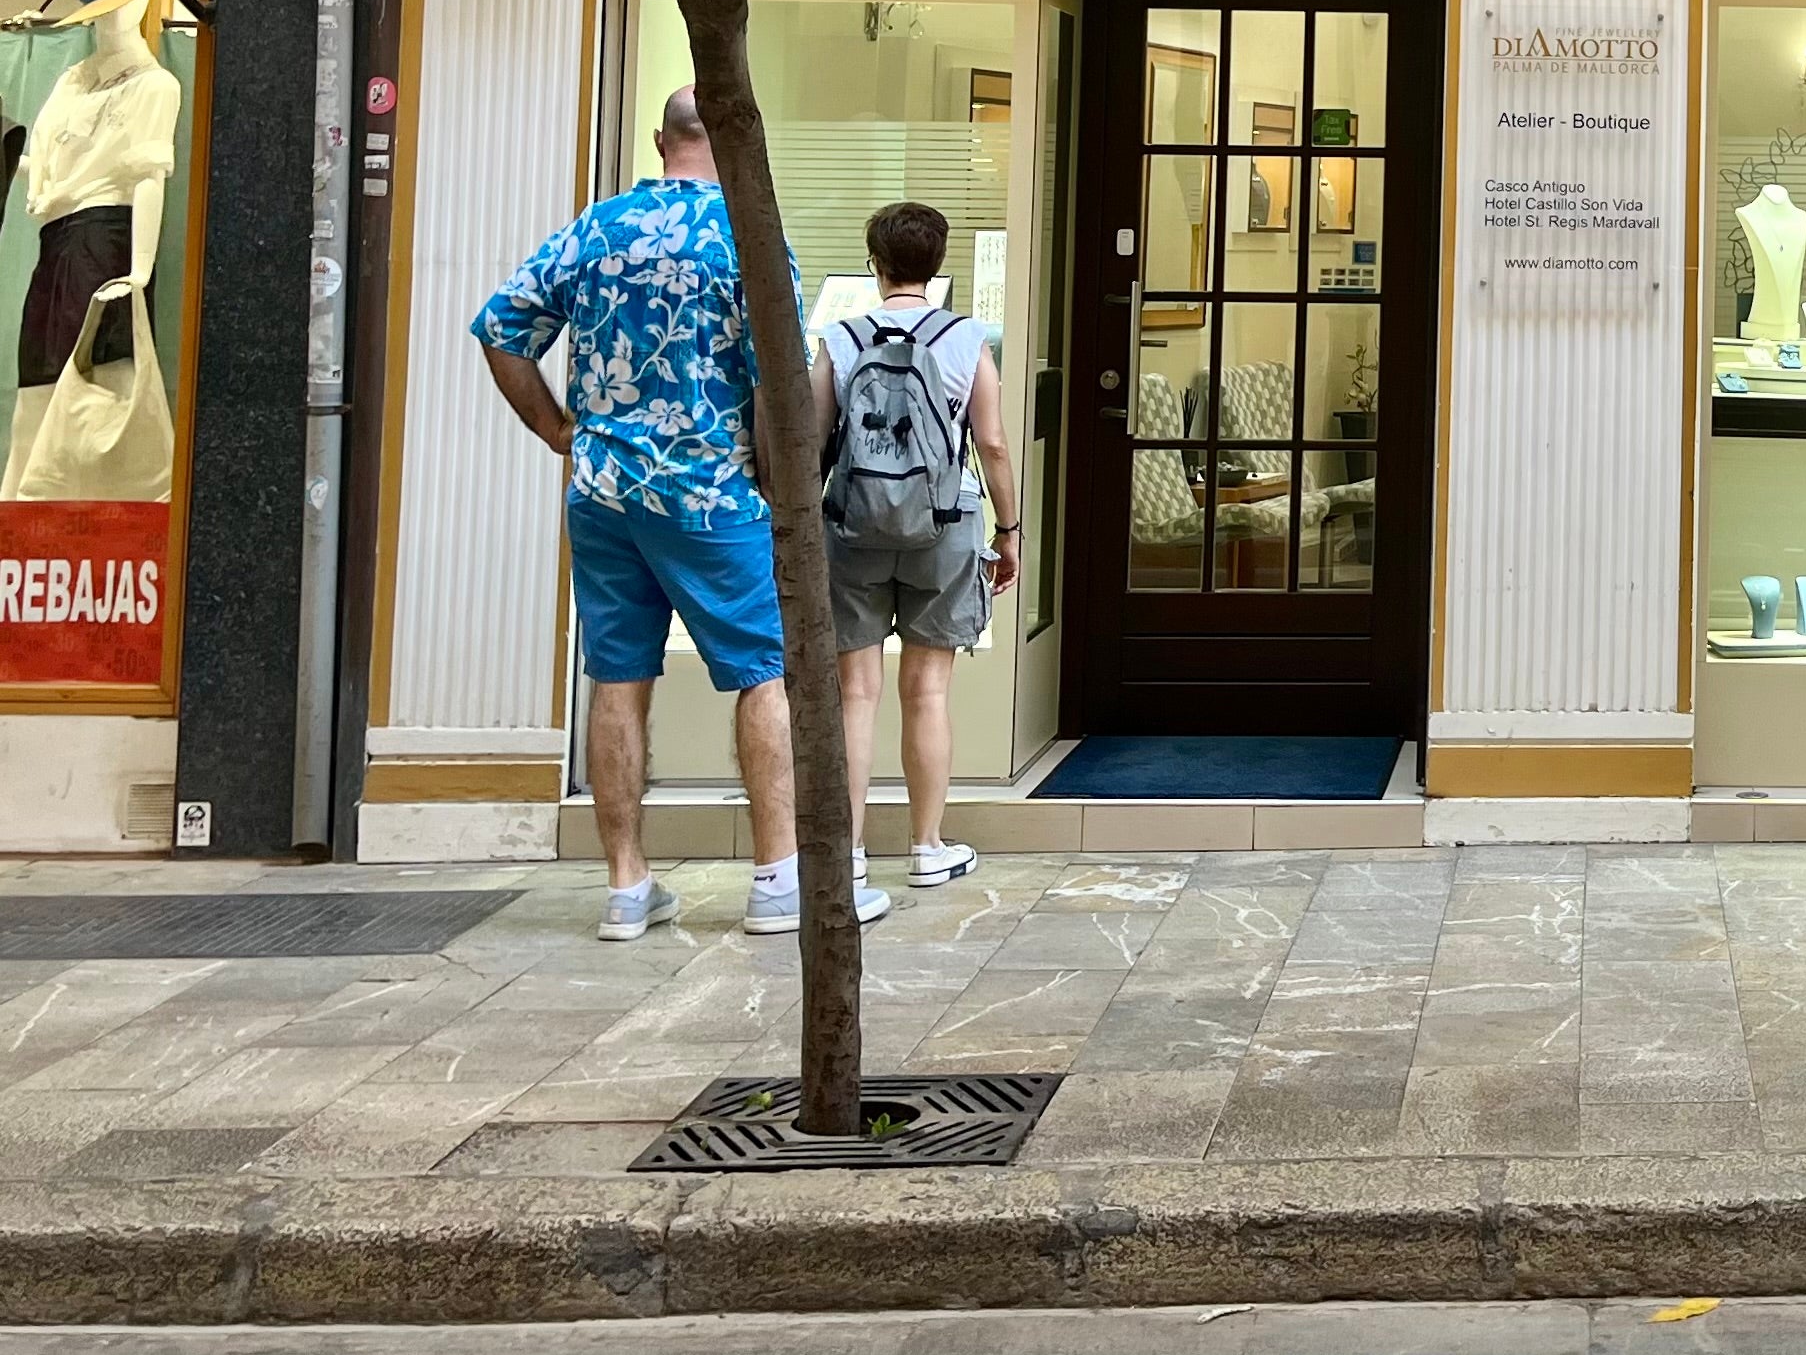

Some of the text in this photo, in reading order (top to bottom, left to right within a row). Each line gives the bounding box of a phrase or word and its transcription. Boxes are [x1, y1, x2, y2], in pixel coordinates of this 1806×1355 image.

[1555, 27, 1661, 38] FINE JEWELLERY
[1492, 28, 1659, 60] DIAMOTTO
[1493, 61, 1661, 75] PALMA DE MALLORCA
[1497, 112, 1555, 128] Atelier
[1573, 113, 1651, 133] Boutique
[1485, 179, 1586, 196] Casco Antiguo
[1485, 197, 1643, 212] Hotel Castillo Son Vida
[1484, 214, 1521, 227] Hotel
[1548, 216, 1588, 231] Regis
[1592, 216, 1660, 229] Mardavall
[1504, 256, 1638, 270] www.diamotto.com
[0, 559, 158, 624] REBAJAS
